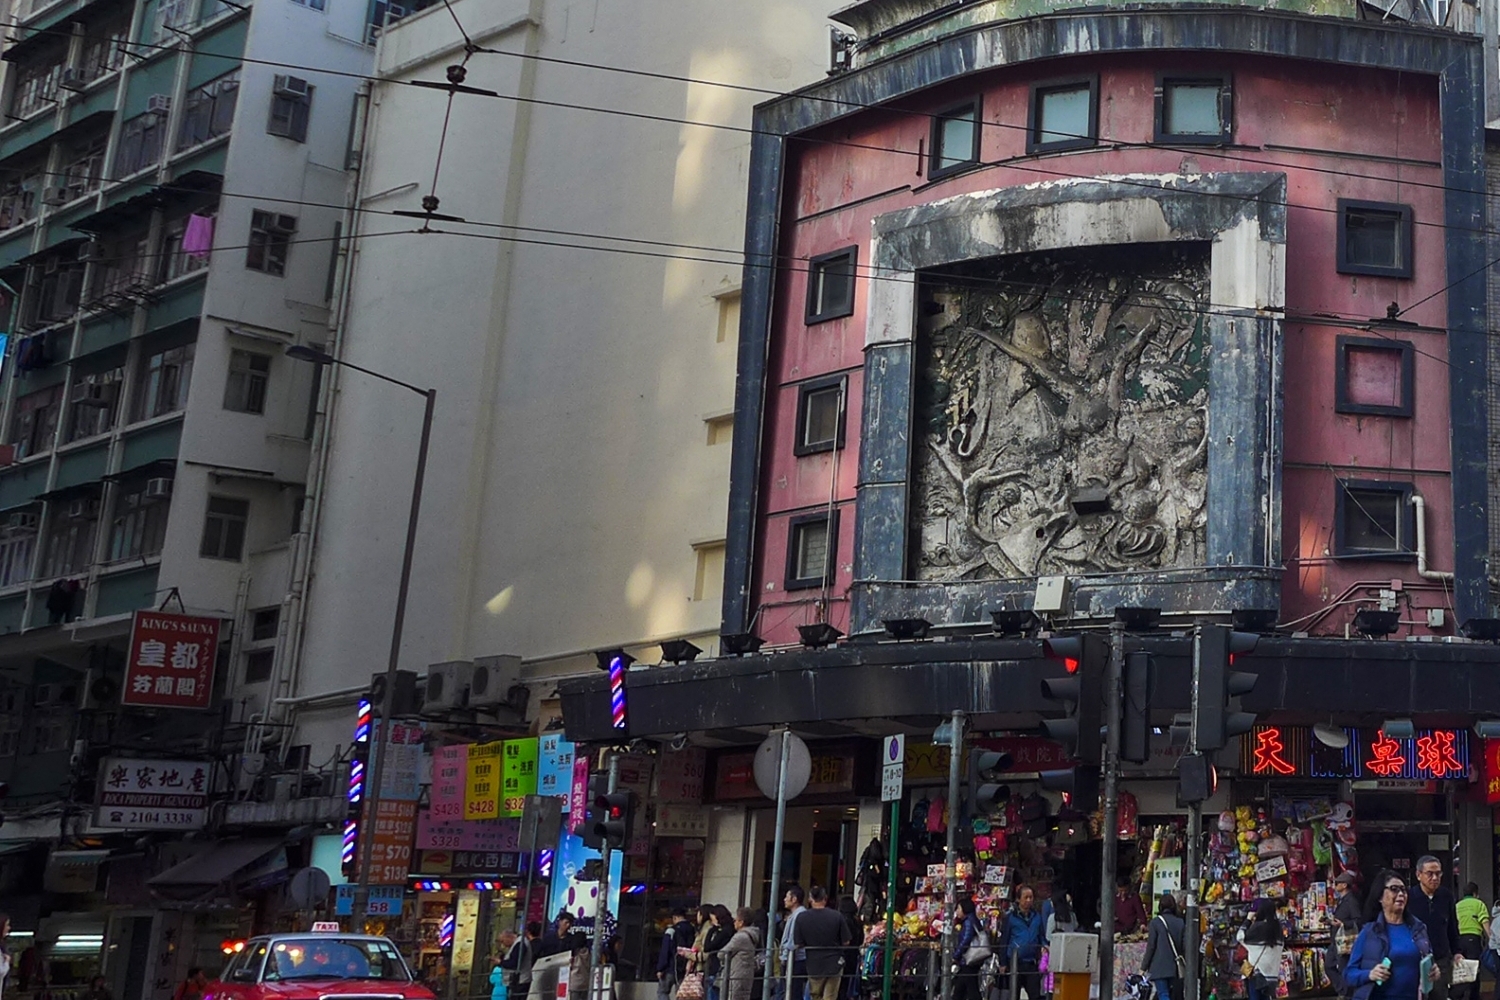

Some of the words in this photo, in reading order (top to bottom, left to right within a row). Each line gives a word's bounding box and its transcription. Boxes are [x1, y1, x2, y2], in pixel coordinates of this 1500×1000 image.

[141, 618, 178, 632] KING'S
[179, 621, 214, 635] SAUNA
[136, 638, 200, 670] 皇都
[133, 674, 196, 697] 芬蘭閣
[1253, 729, 1296, 774] 天
[1366, 730, 1463, 776] 桌球
[107, 765, 206, 792] 樂家地產
[434, 803, 460, 816] $428
[468, 800, 495, 814] $428
[504, 797, 525, 811] $32
[130, 811, 160, 823] 2104
[163, 812, 193, 824] 3338
[431, 835, 460, 847] $328
[386, 845, 410, 860] $70
[383, 866, 408, 881] $138
[369, 902, 389, 913] 58
[316, 923, 337, 931] TAXI
